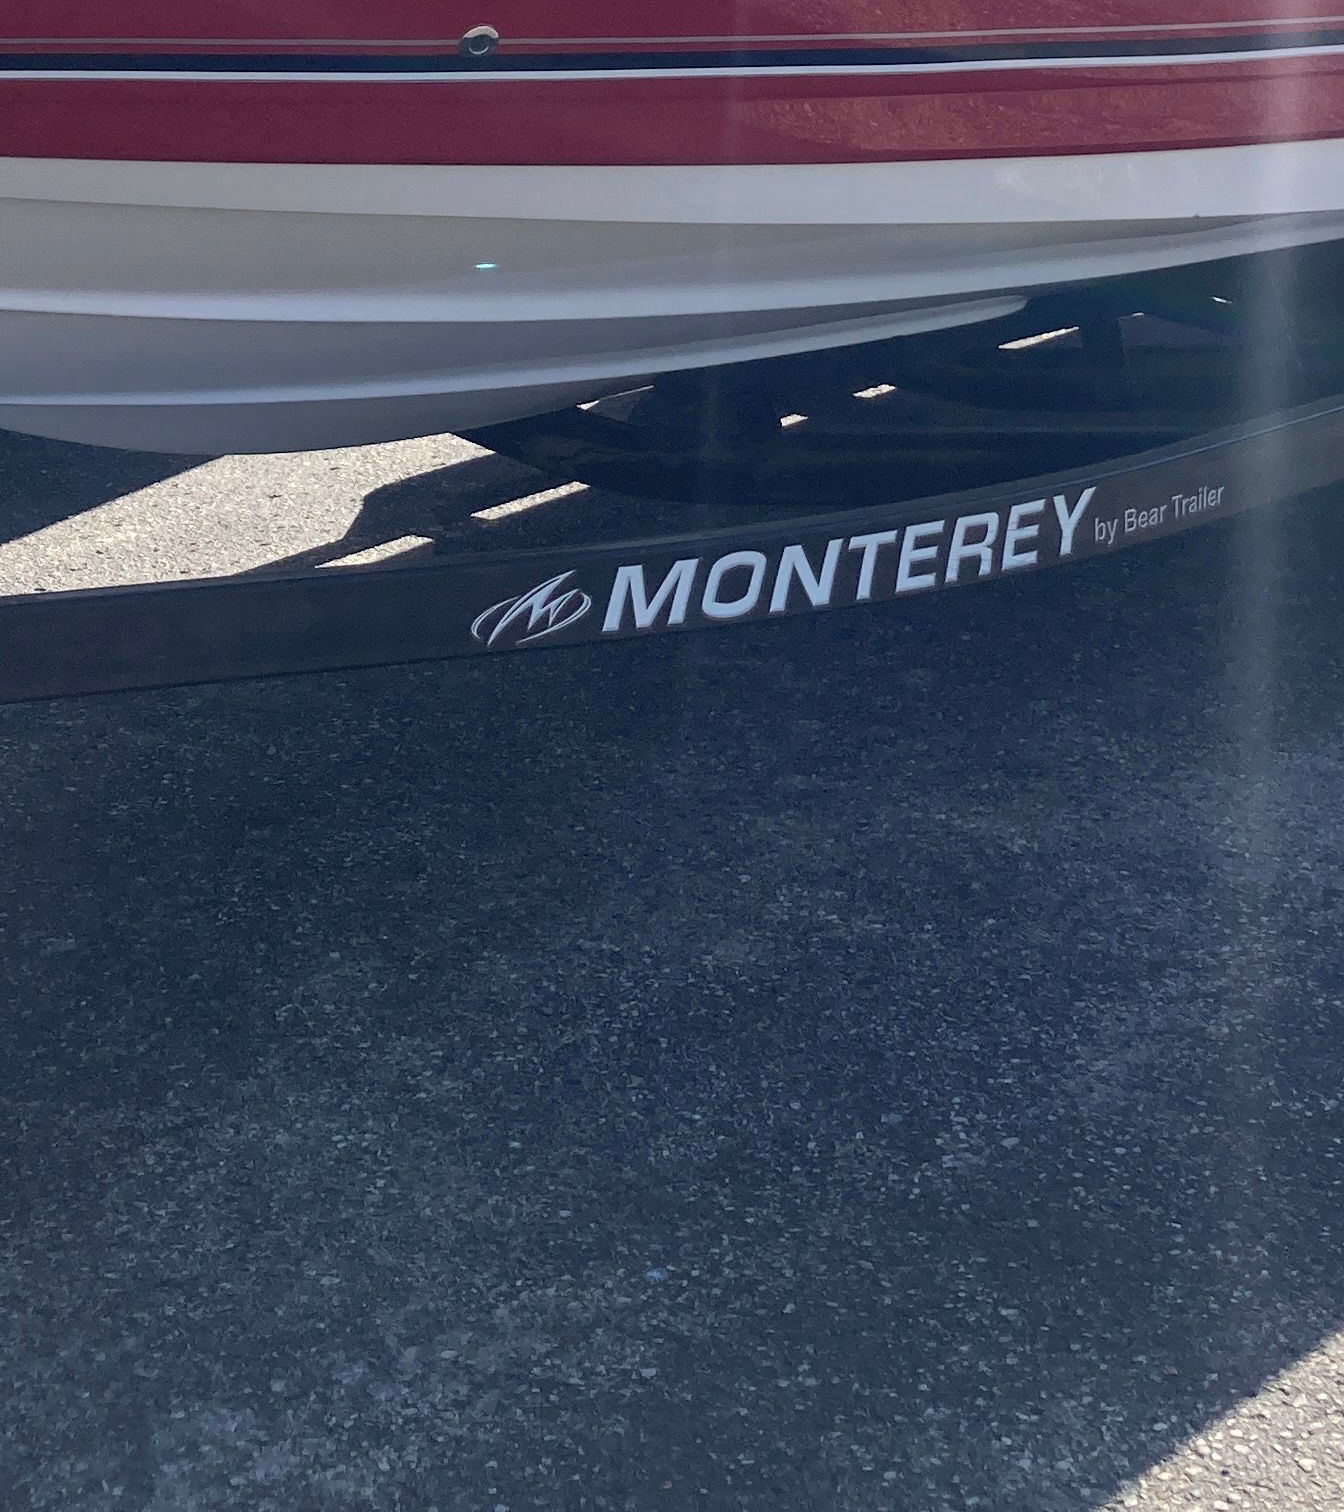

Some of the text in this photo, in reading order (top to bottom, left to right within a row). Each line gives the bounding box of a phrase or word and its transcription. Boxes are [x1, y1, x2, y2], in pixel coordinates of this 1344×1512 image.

[602, 486, 1225, 633] MONTEREY by Bear Trailer
